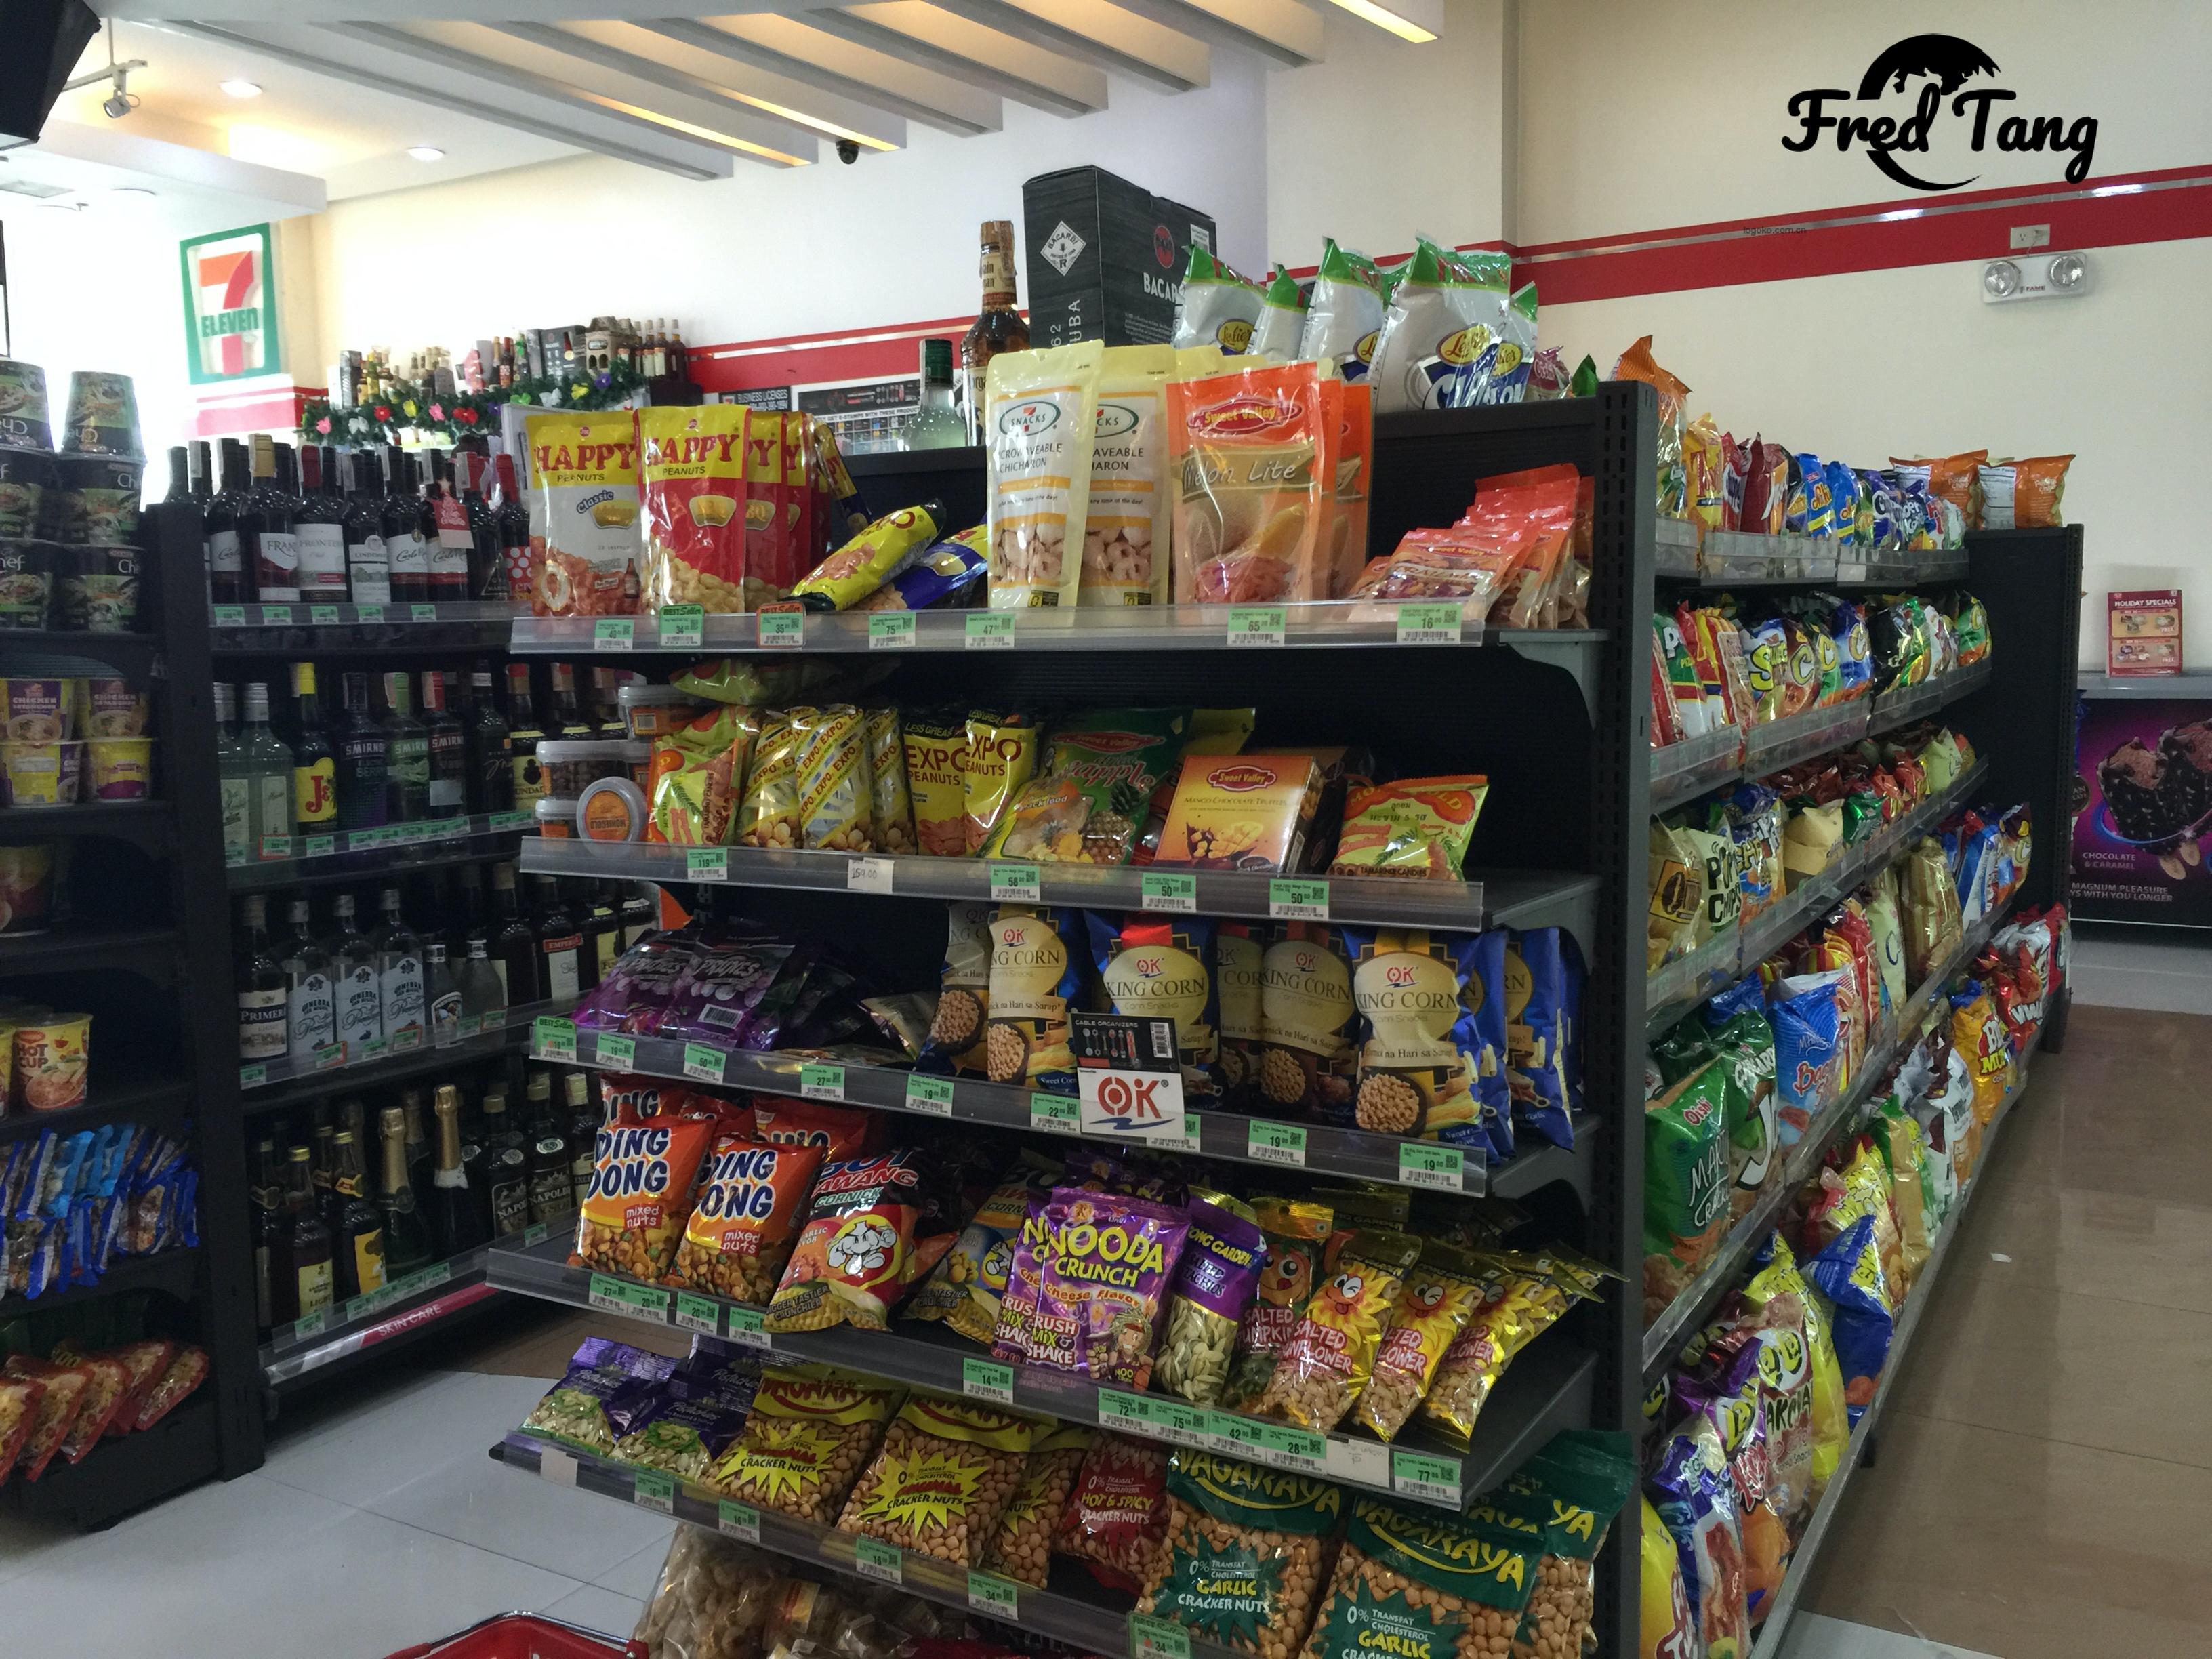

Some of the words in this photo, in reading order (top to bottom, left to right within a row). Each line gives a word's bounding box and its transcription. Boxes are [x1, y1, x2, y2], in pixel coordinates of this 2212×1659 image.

[1048, 232, 1078, 249] BACARDI
[2026, 285, 2046, 293] FAME
[200, 250, 253, 375] 7
[763, 390, 787, 400] LICENSES
[1011, 413, 1046, 426] SNACKS
[1204, 411, 1239, 424] Sweet
[1242, 407, 1276, 422] Valley
[663, 466, 705, 476] PEANUTS
[1248, 462, 1296, 482] Lite
[576, 489, 614, 515] Classic
[680, 605, 702, 615] Seller
[776, 624, 784, 633] 35
[886, 626, 895, 634] 75
[984, 626, 993, 634] 47
[1249, 621, 1260, 631] 65
[1422, 618, 1433, 629] 16
[820, 722, 843, 745] EXPO
[804, 745, 820, 770] EXPO
[833, 745, 856, 771] EXPO
[874, 745, 896, 771] EXPO
[754, 764, 777, 783] EXPO
[908, 771, 960, 786] PEANUTS
[1219, 773, 1243, 782] Sweet
[1244, 774, 1266, 784] Valley
[815, 773, 832, 795] EXPO
[698, 859, 710, 867] 119
[2082, 852, 2136, 861] CHOCOLATE
[2093, 861, 2135, 870] CARAMEL
[1008, 877, 1018, 886] 58
[2071, 882, 2118, 892] MAGNUM
[2119, 884, 2169, 895] PLEASURE
[1162, 886, 1172, 897] 50
[1291, 893, 1303, 904] 50
[2110, 892, 2131, 900] YOU
[2133, 893, 2173, 902] LONGER
[1004, 928, 1025, 943] OK
[1014, 949, 1059, 966] CORN
[1296, 951, 1316, 968] OK
[1137, 958, 1162, 975] OK
[1387, 966, 1416, 983] OK
[1107, 980, 1146, 998] KING
[1151, 978, 1205, 995] CORN
[1304, 977, 1351, 1000] CORN
[1401, 991, 1456, 1008] CORN
[241, 1006, 286, 1021] PRIMER
[539, 1018, 554, 1027] BEST
[554, 1019, 573, 1030] Seller
[1097, 1021, 1139, 1029] ORGANIZERS
[17, 1044, 49, 1057] HOT
[1397, 1048, 1419, 1058] Hari
[1421, 1050, 1431, 1058] sa
[18, 1057, 49, 1068] CUP
[817, 1076, 825, 1086] 27
[1040, 1076, 1061, 1085] Sweet
[924, 1090, 933, 1100] 19
[1097, 1076, 1160, 1120] OK
[1048, 1107, 1059, 1118] 22
[1683, 1095, 1714, 1126] Oishi
[1270, 1136, 1280, 1147] 19
[1424, 1160, 1435, 1171] 19
[816, 1187, 884, 1208] CORNICK
[626, 1206, 660, 1218] mixed
[626, 1215, 657, 1228] nuts
[725, 1231, 760, 1242] mixed
[723, 1241, 756, 1254] nuts
[1046, 1224, 1164, 1274] NOODA
[1212, 1240, 1253, 1267] GARDEN
[1054, 1256, 1139, 1288] CRUNCH
[603, 1287, 612, 1296] 27
[792, 1286, 830, 1306] TASTIER
[1045, 1282, 1092, 1301] Cheese
[1097, 1288, 1141, 1308] Flavor
[642, 1298, 651, 1307] 20
[775, 1298, 823, 1321] CRUNCHIER
[379, 1317, 407, 1336] SKIN
[409, 1304, 442, 1324] CARE
[1244, 1308, 1294, 1326] SALTED
[1295, 1319, 1347, 1349] SALTED
[1027, 1344, 1076, 1366] SHAKE
[982, 1374, 991, 1385] 14
[1119, 1405, 1129, 1416] 72
[1173, 1416, 1184, 1429] 75
[1229, 1428, 1241, 1439] 42
[1288, 1443, 1299, 1454] 28
[741, 1457, 786, 1470] CRACKER
[787, 1464, 817, 1473] NUTS
[1088, 1475, 1105, 1491] 0%
[1107, 1476, 1135, 1486] TRANSFAT
[1417, 1471, 1430, 1482] 77
[887, 1493, 931, 1510] CRACKER
[933, 1494, 963, 1507] NUTS
[1081, 1492, 1103, 1509] HOT
[1105, 1495, 1115, 1508] &
[1117, 1495, 1155, 1511] SPICY
[1080, 1508, 1121, 1523] CRACKER
[1122, 1511, 1150, 1525] NUTS
[1189, 1559, 1210, 1576] 0%
[1212, 1560, 1246, 1571] TRANSFAT
[1210, 1570, 1257, 1580] CHOLESTEROL
[986, 1590, 996, 1601] 34
[1195, 1580, 1258, 1597] GARLIC
[1177, 1595, 1232, 1612] CRACKER
[1234, 1597, 1271, 1614] NUTS
[1346, 1605, 1370, 1624] 0%
[1372, 1609, 1416, 1626] TRANSFAT
[1370, 1621, 1429, 1642] CHOLESTEROL
[1155, 1642, 1166, 1653] 34
[1357, 1630, 1431, 1659] GARLIC
